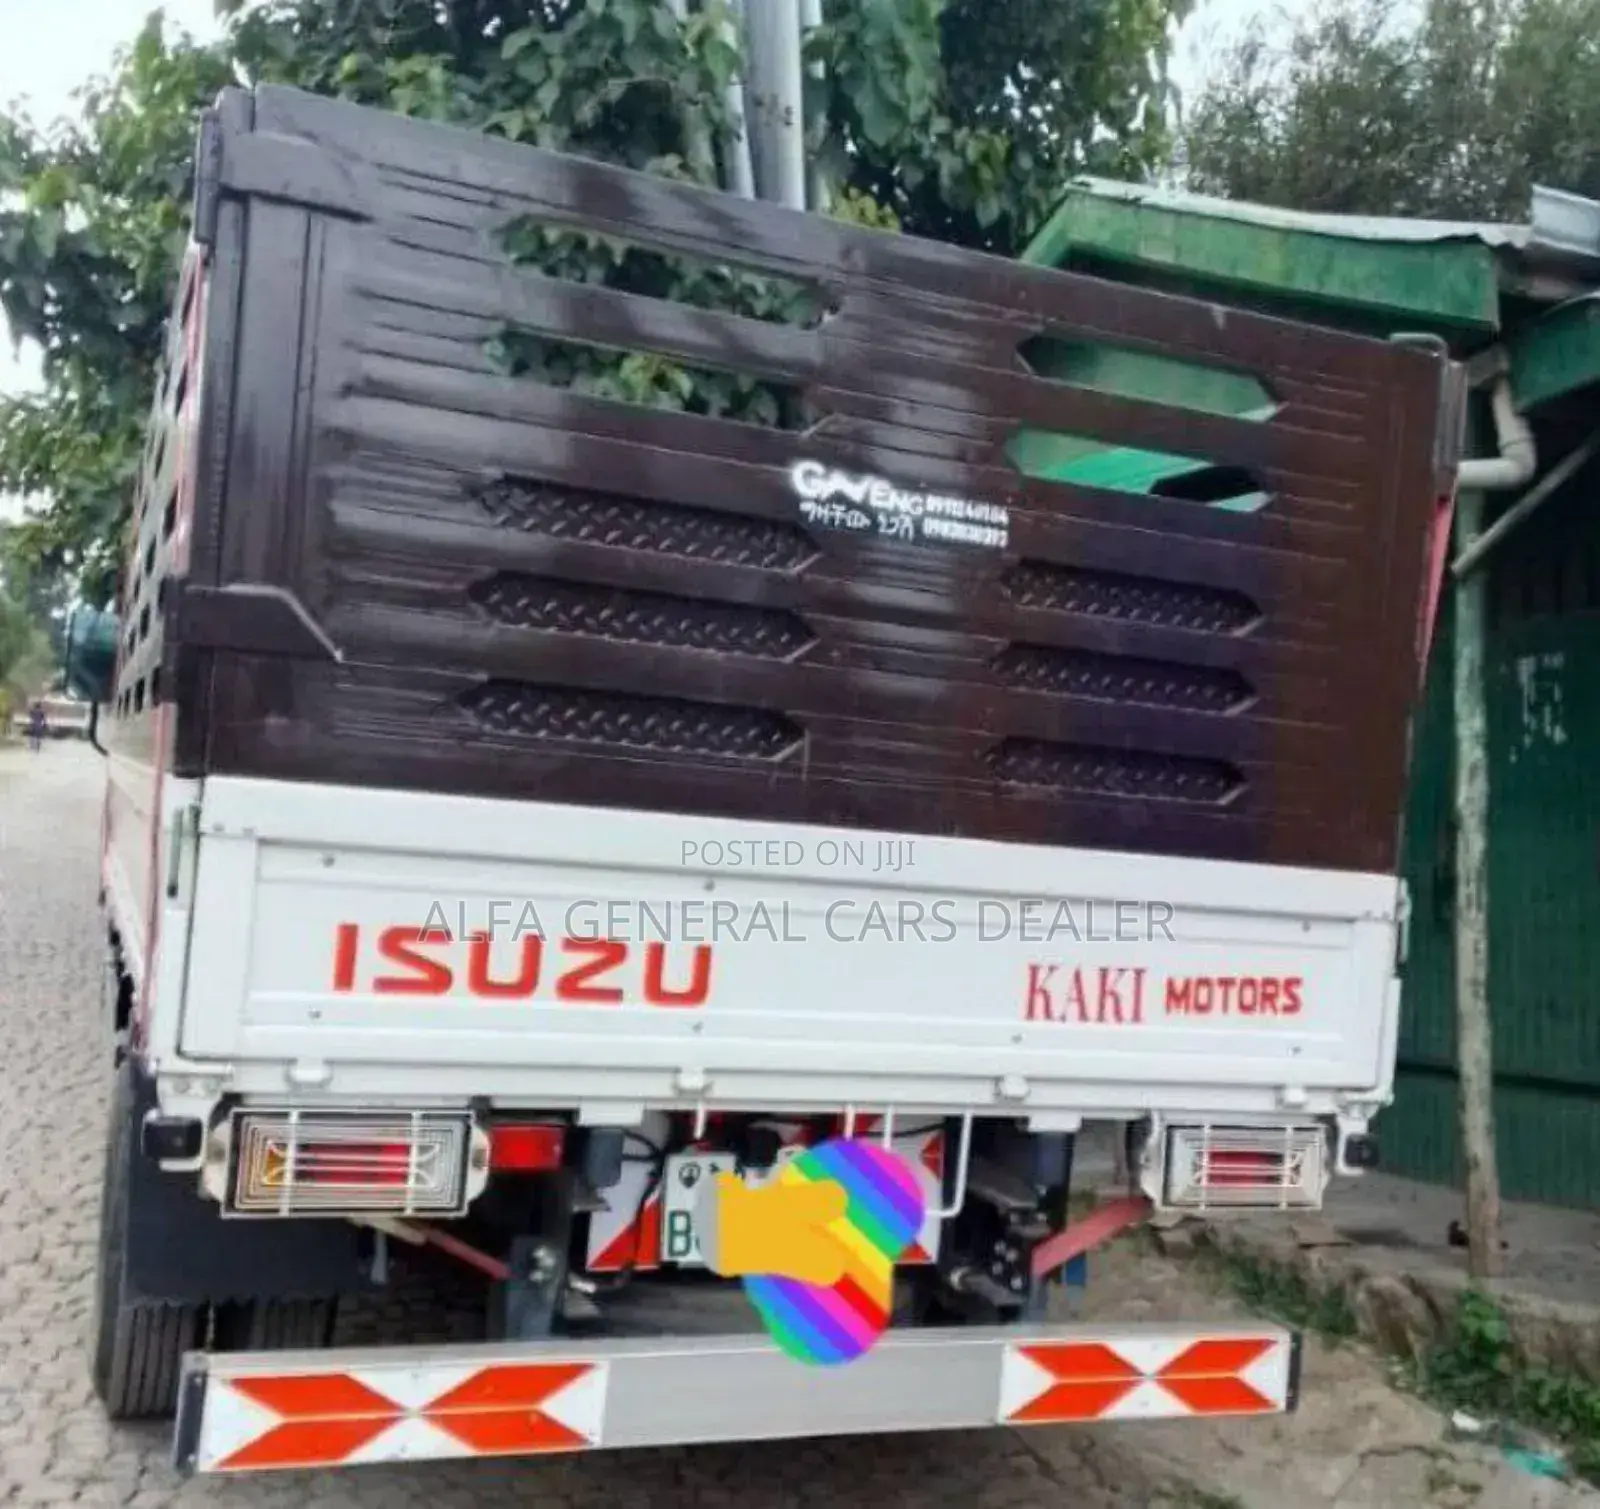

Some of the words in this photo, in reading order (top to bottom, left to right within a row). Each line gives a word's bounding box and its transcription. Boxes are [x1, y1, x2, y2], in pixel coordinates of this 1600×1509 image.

[333, 922, 713, 1007] ISUZU
[1024, 962, 1149, 1024] KAKI
[1165, 976, 1303, 1016] MOTORS
